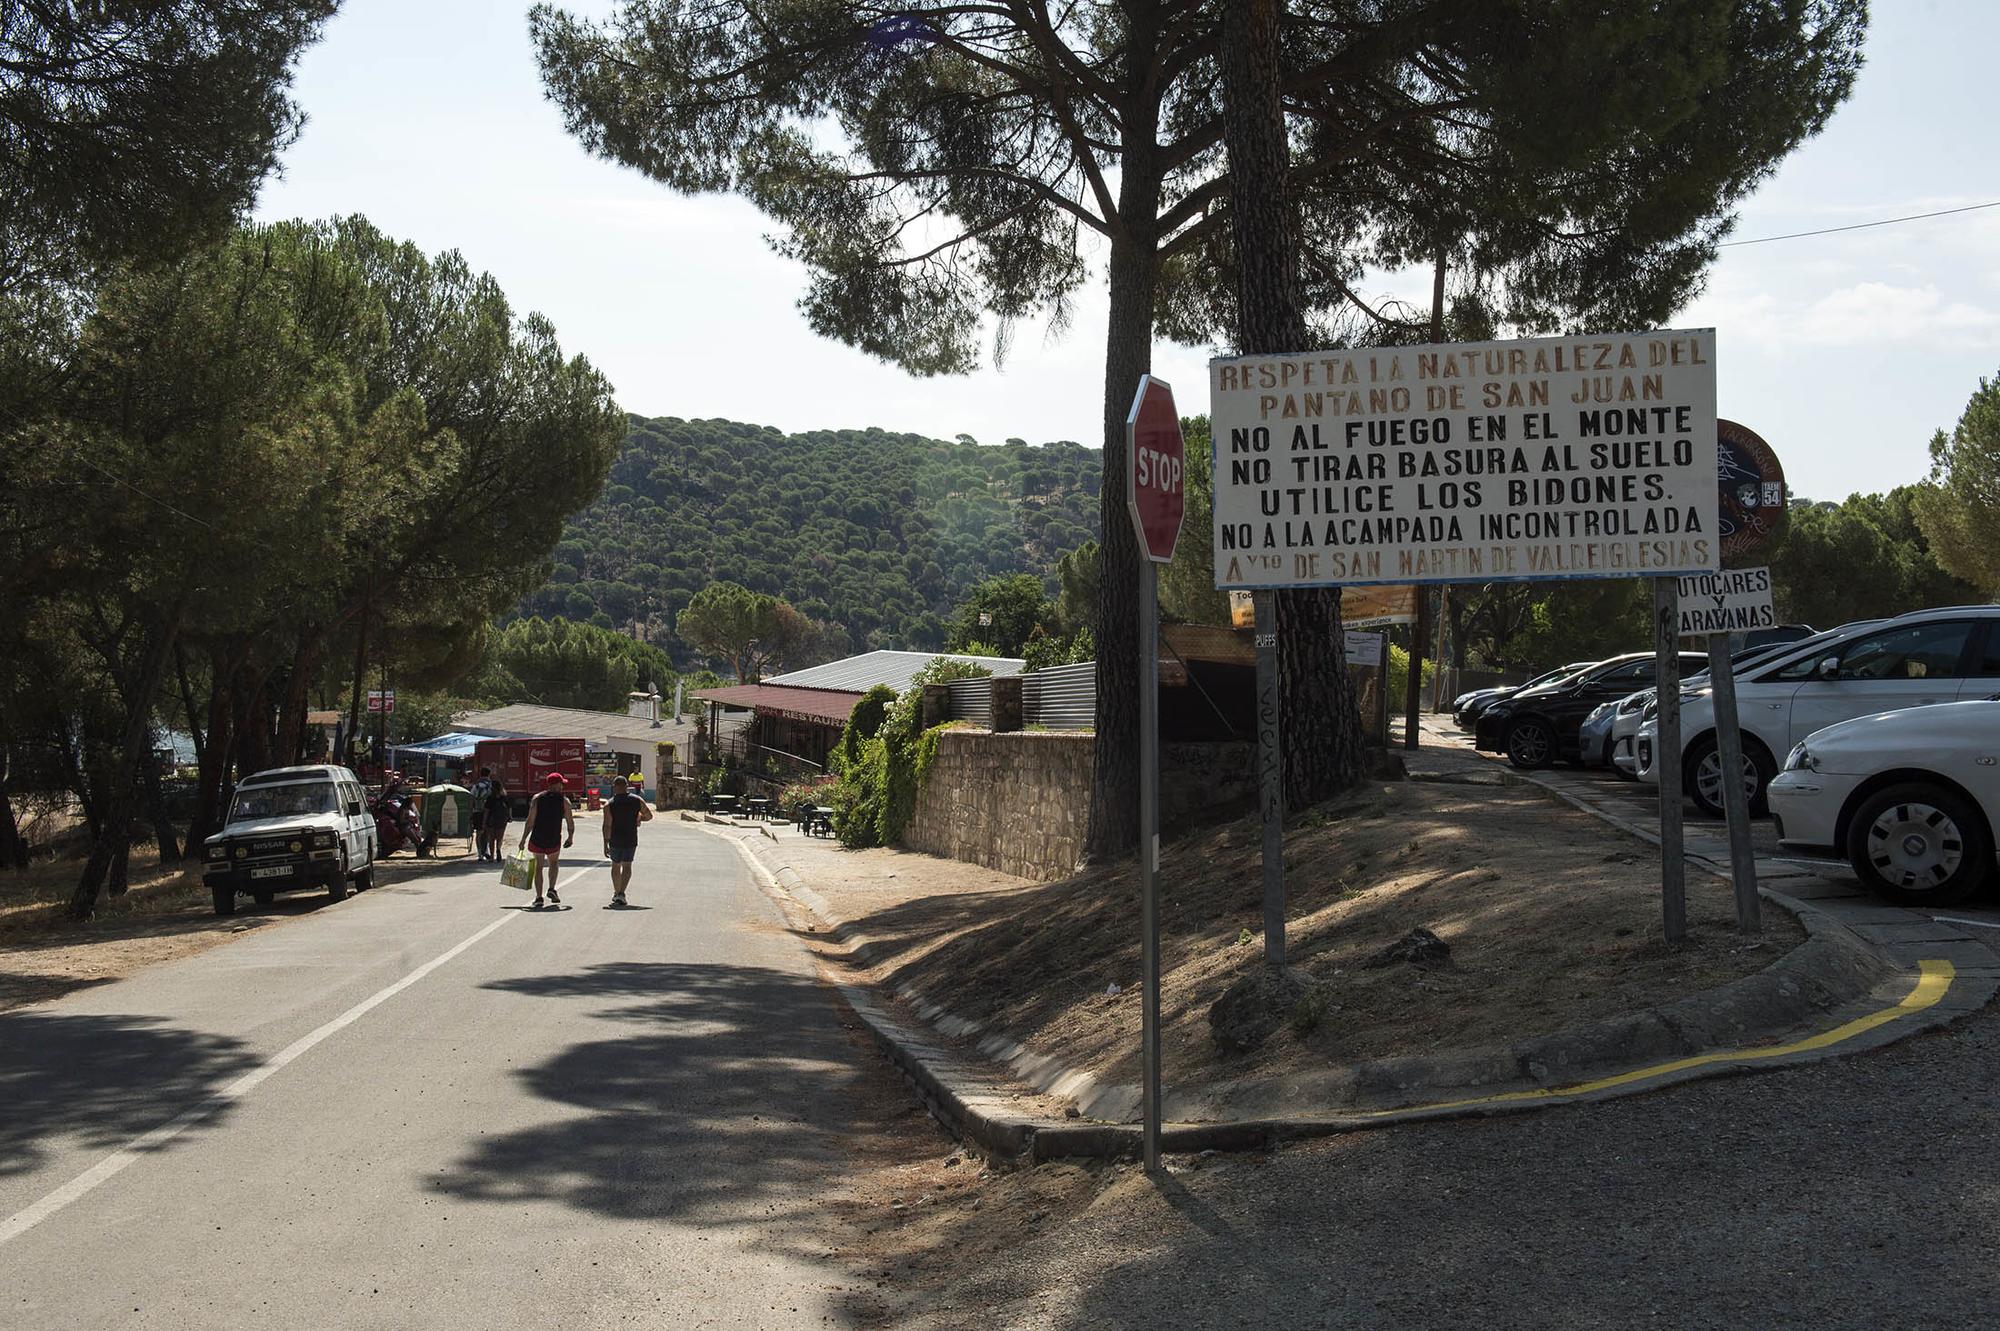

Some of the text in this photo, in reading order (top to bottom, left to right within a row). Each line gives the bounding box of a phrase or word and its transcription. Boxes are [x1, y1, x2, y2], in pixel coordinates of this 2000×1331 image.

[1219, 338, 1707, 391] RESPETA LA NATURALEZA DEL
[1259, 374, 1664, 420] PANTANO DE SAN JUAN
[1231, 406, 1692, 454] NO AL FUEGO EN EL MONTE
[1138, 446, 1181, 494] STOP
[1231, 458, 1271, 486] NO
[1291, 453, 1387, 483] TIRAR
[1399, 447, 1529, 478] BASURA
[1541, 445, 1579, 472] AL
[1590, 439, 1693, 470] SUELO
[1260, 473, 1673, 517] UTILICE LOS BIDONES.
[1764, 491, 1780, 504] 54
[1222, 506, 1703, 550] NO A LA ACAMPADA INCONTROLADA
[1294, 552, 1321, 580] DE
[1332, 550, 1381, 579] SAN
[1491, 545, 1517, 574] DE
[1526, 539, 1710, 572] VALDEIGLESIAS
[1677, 570, 1769, 598] UTOCARES
[1711, 595, 1726, 609] Y
[1678, 604, 1773, 632] ARAVANAS
[783, 710, 848, 728] RESTAURA
[253, 841, 286, 849] NISSAN
